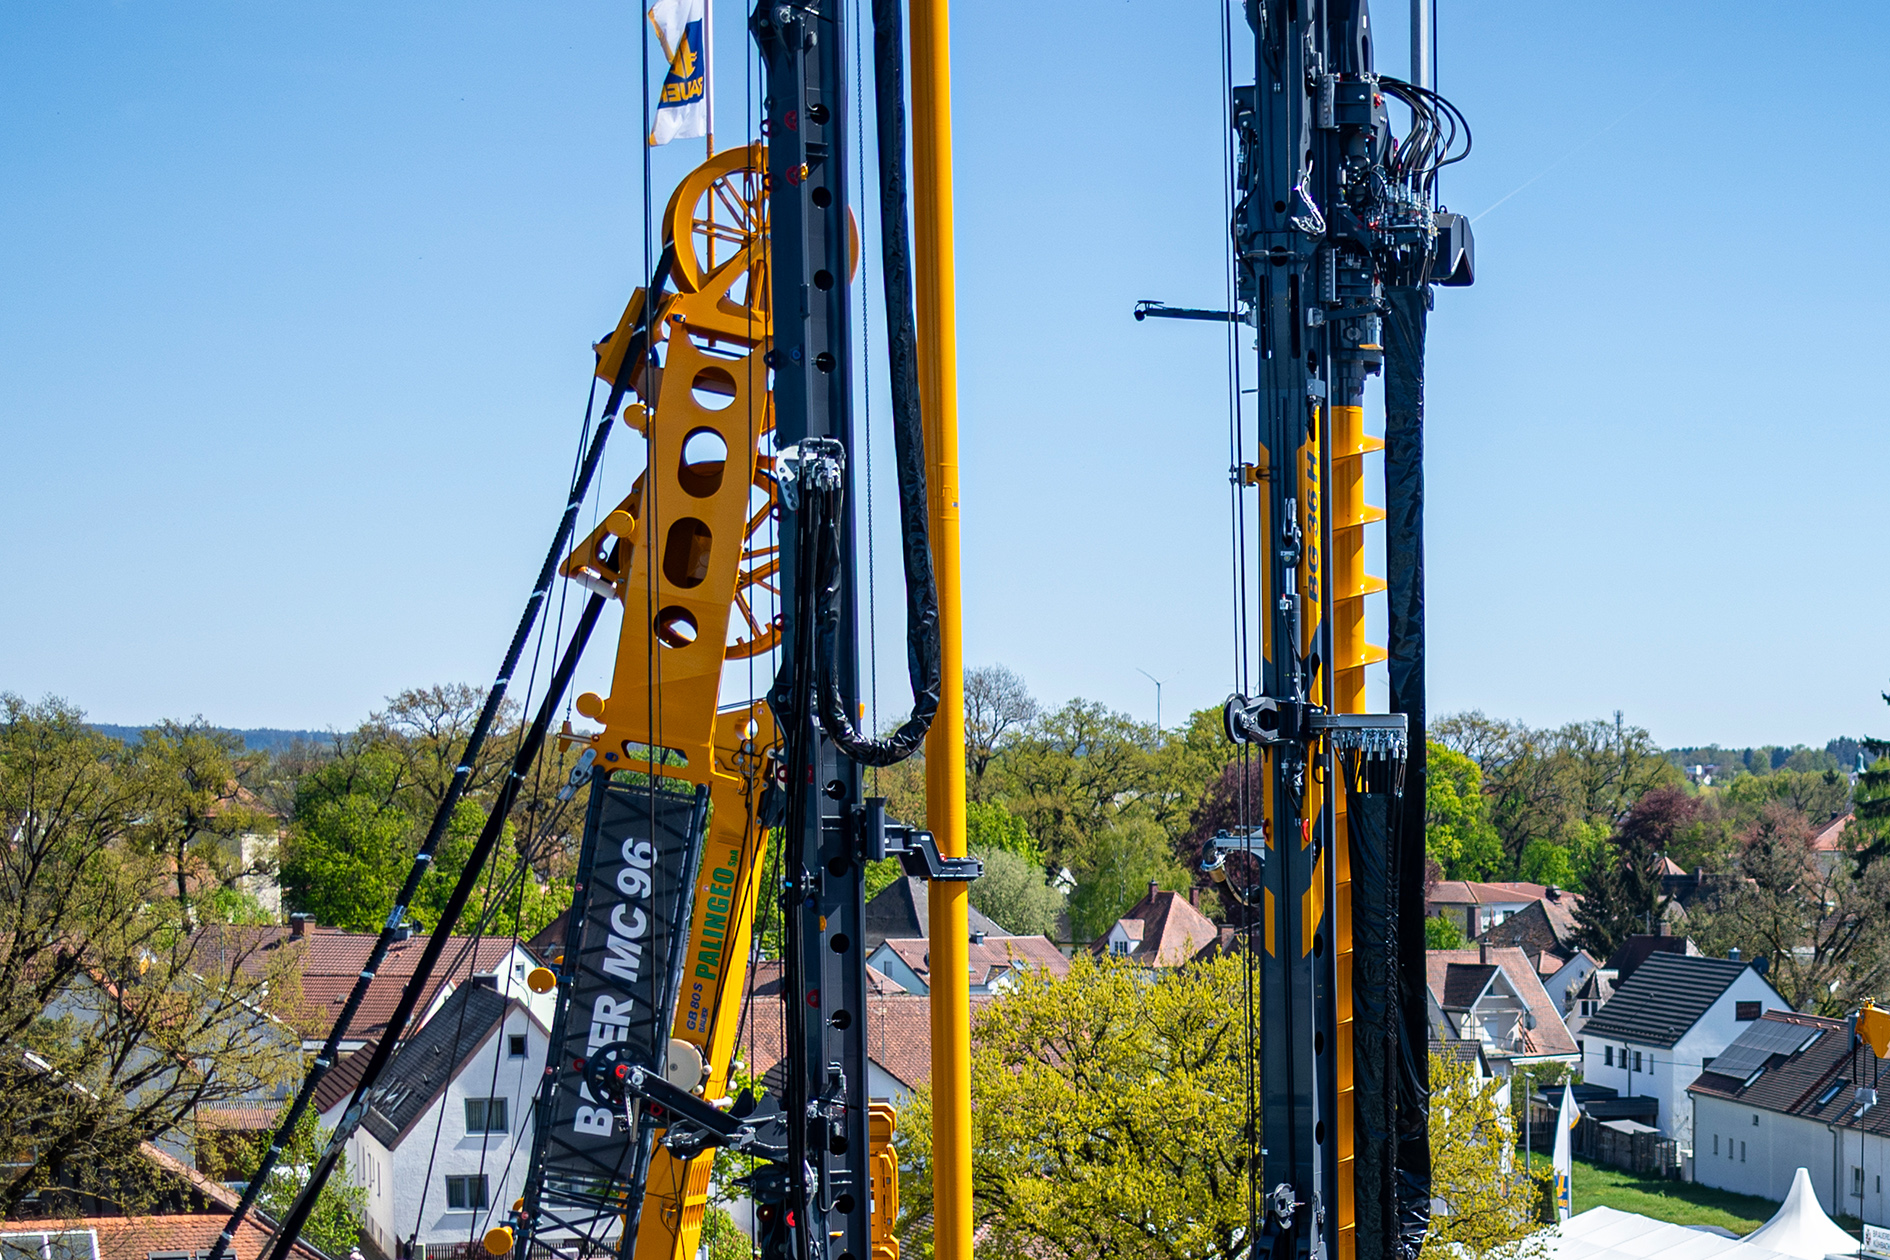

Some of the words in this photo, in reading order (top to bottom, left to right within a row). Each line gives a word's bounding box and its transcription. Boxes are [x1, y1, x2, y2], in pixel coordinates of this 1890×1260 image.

[1307, 451, 1318, 482] H
[1307, 488, 1319, 537] 36
[1308, 544, 1319, 603] BG
[616, 838, 658, 898] 96
[602, 903, 647, 982] MC
[695, 867, 735, 981] PALINGEO
[687, 1010, 698, 1030] GB
[691, 992, 702, 1010] 80
[698, 1007, 709, 1033] BAUER
